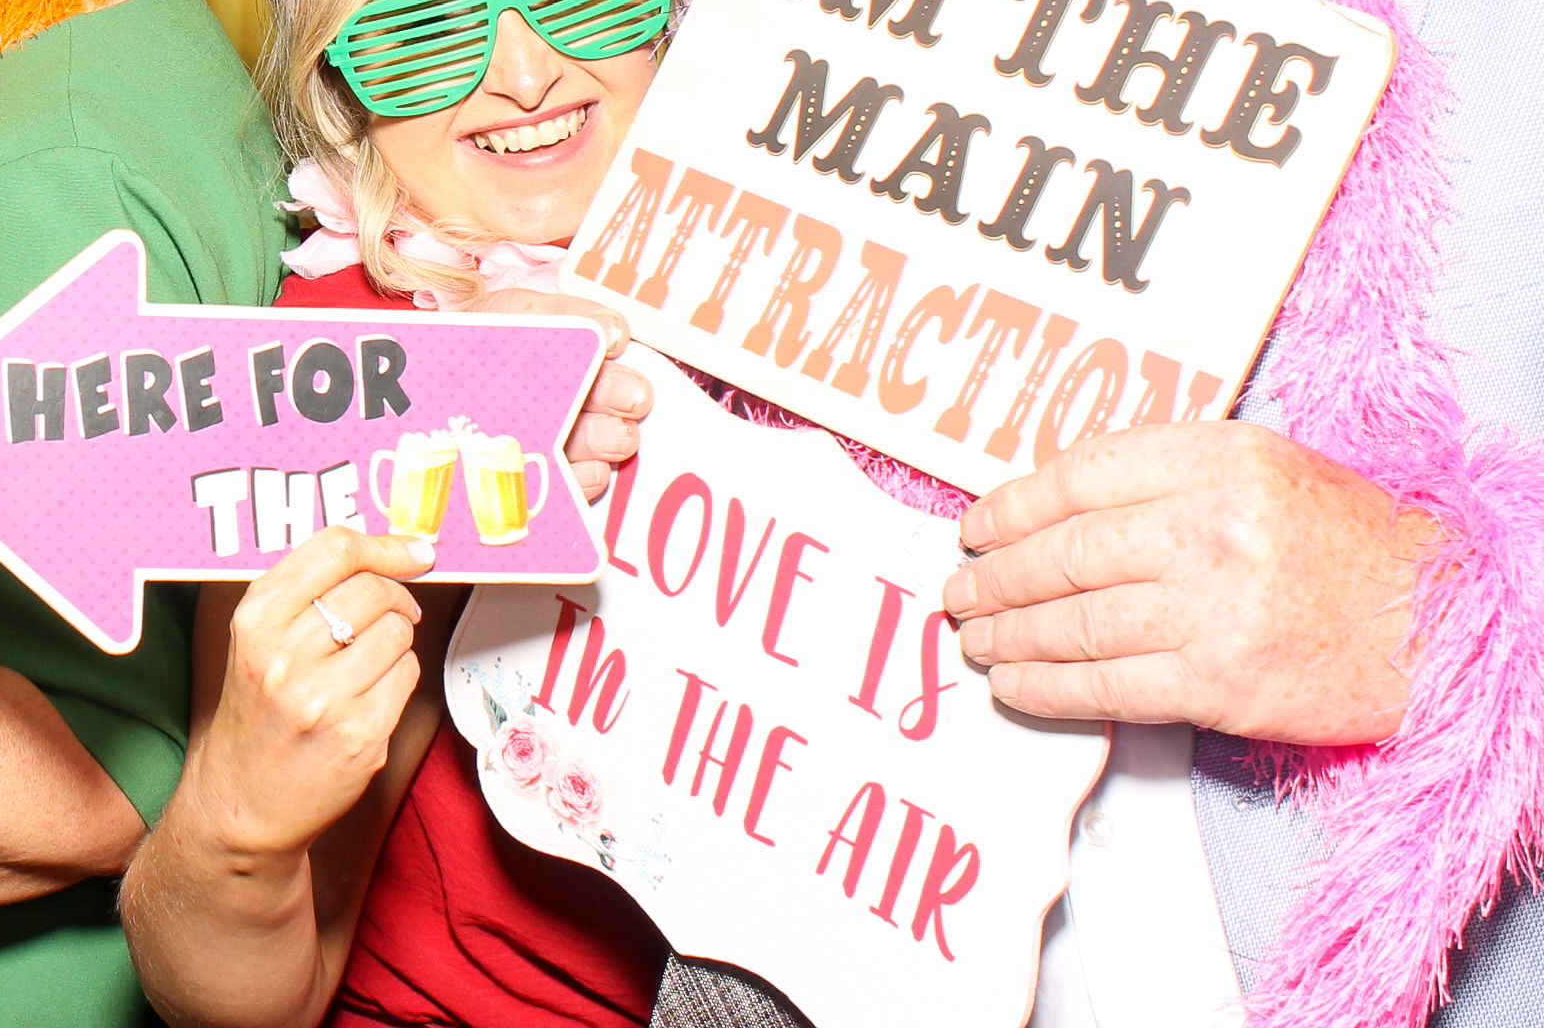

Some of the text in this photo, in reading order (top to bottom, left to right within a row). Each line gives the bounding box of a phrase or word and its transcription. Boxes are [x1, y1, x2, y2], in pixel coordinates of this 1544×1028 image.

[745, 48, 1191, 293] MAIN
[1, 335, 413, 445] HERE FOR
[190, 459, 368, 558] THE
[603, 451, 961, 742] LOVE IS
[662, 668, 809, 847] THE
[815, 781, 981, 963] AIR
